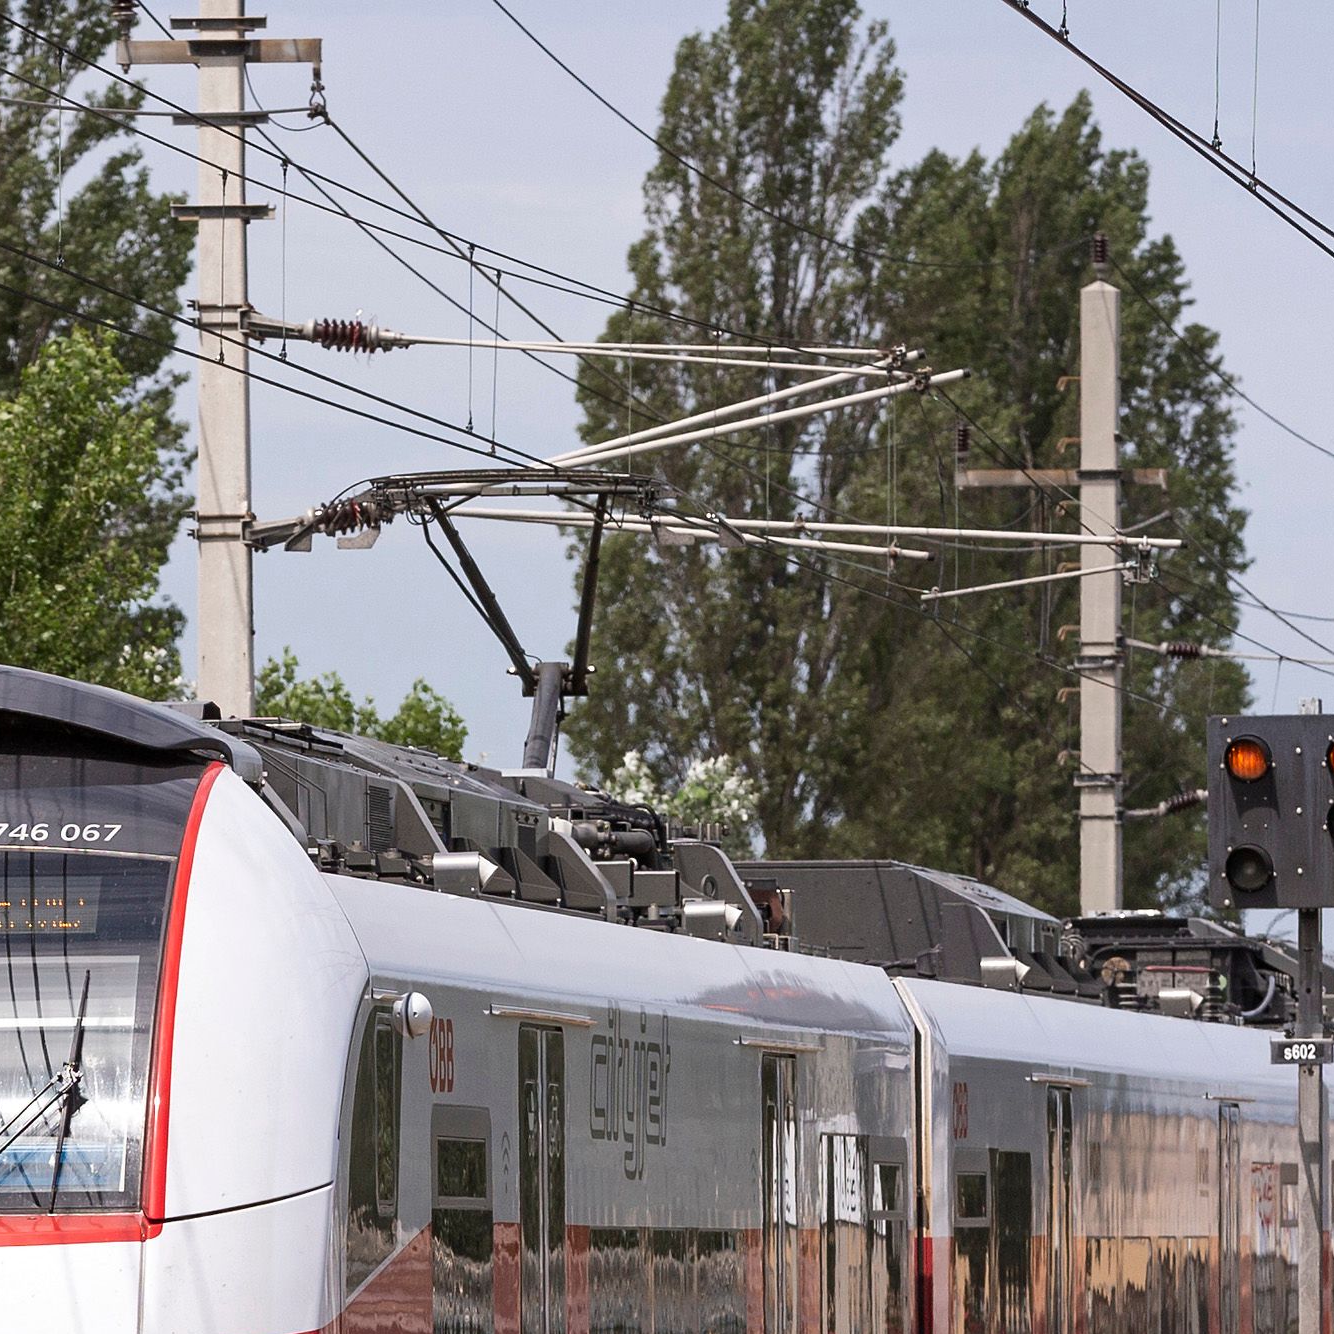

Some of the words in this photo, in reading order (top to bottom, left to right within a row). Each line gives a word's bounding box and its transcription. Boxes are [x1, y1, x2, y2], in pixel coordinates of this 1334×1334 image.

[60, 823, 122, 842] 067
[429, 1016, 455, 1094] ÖBB
[1283, 1043, 1316, 1060] s602
[589, 999, 671, 1181] cityjet
